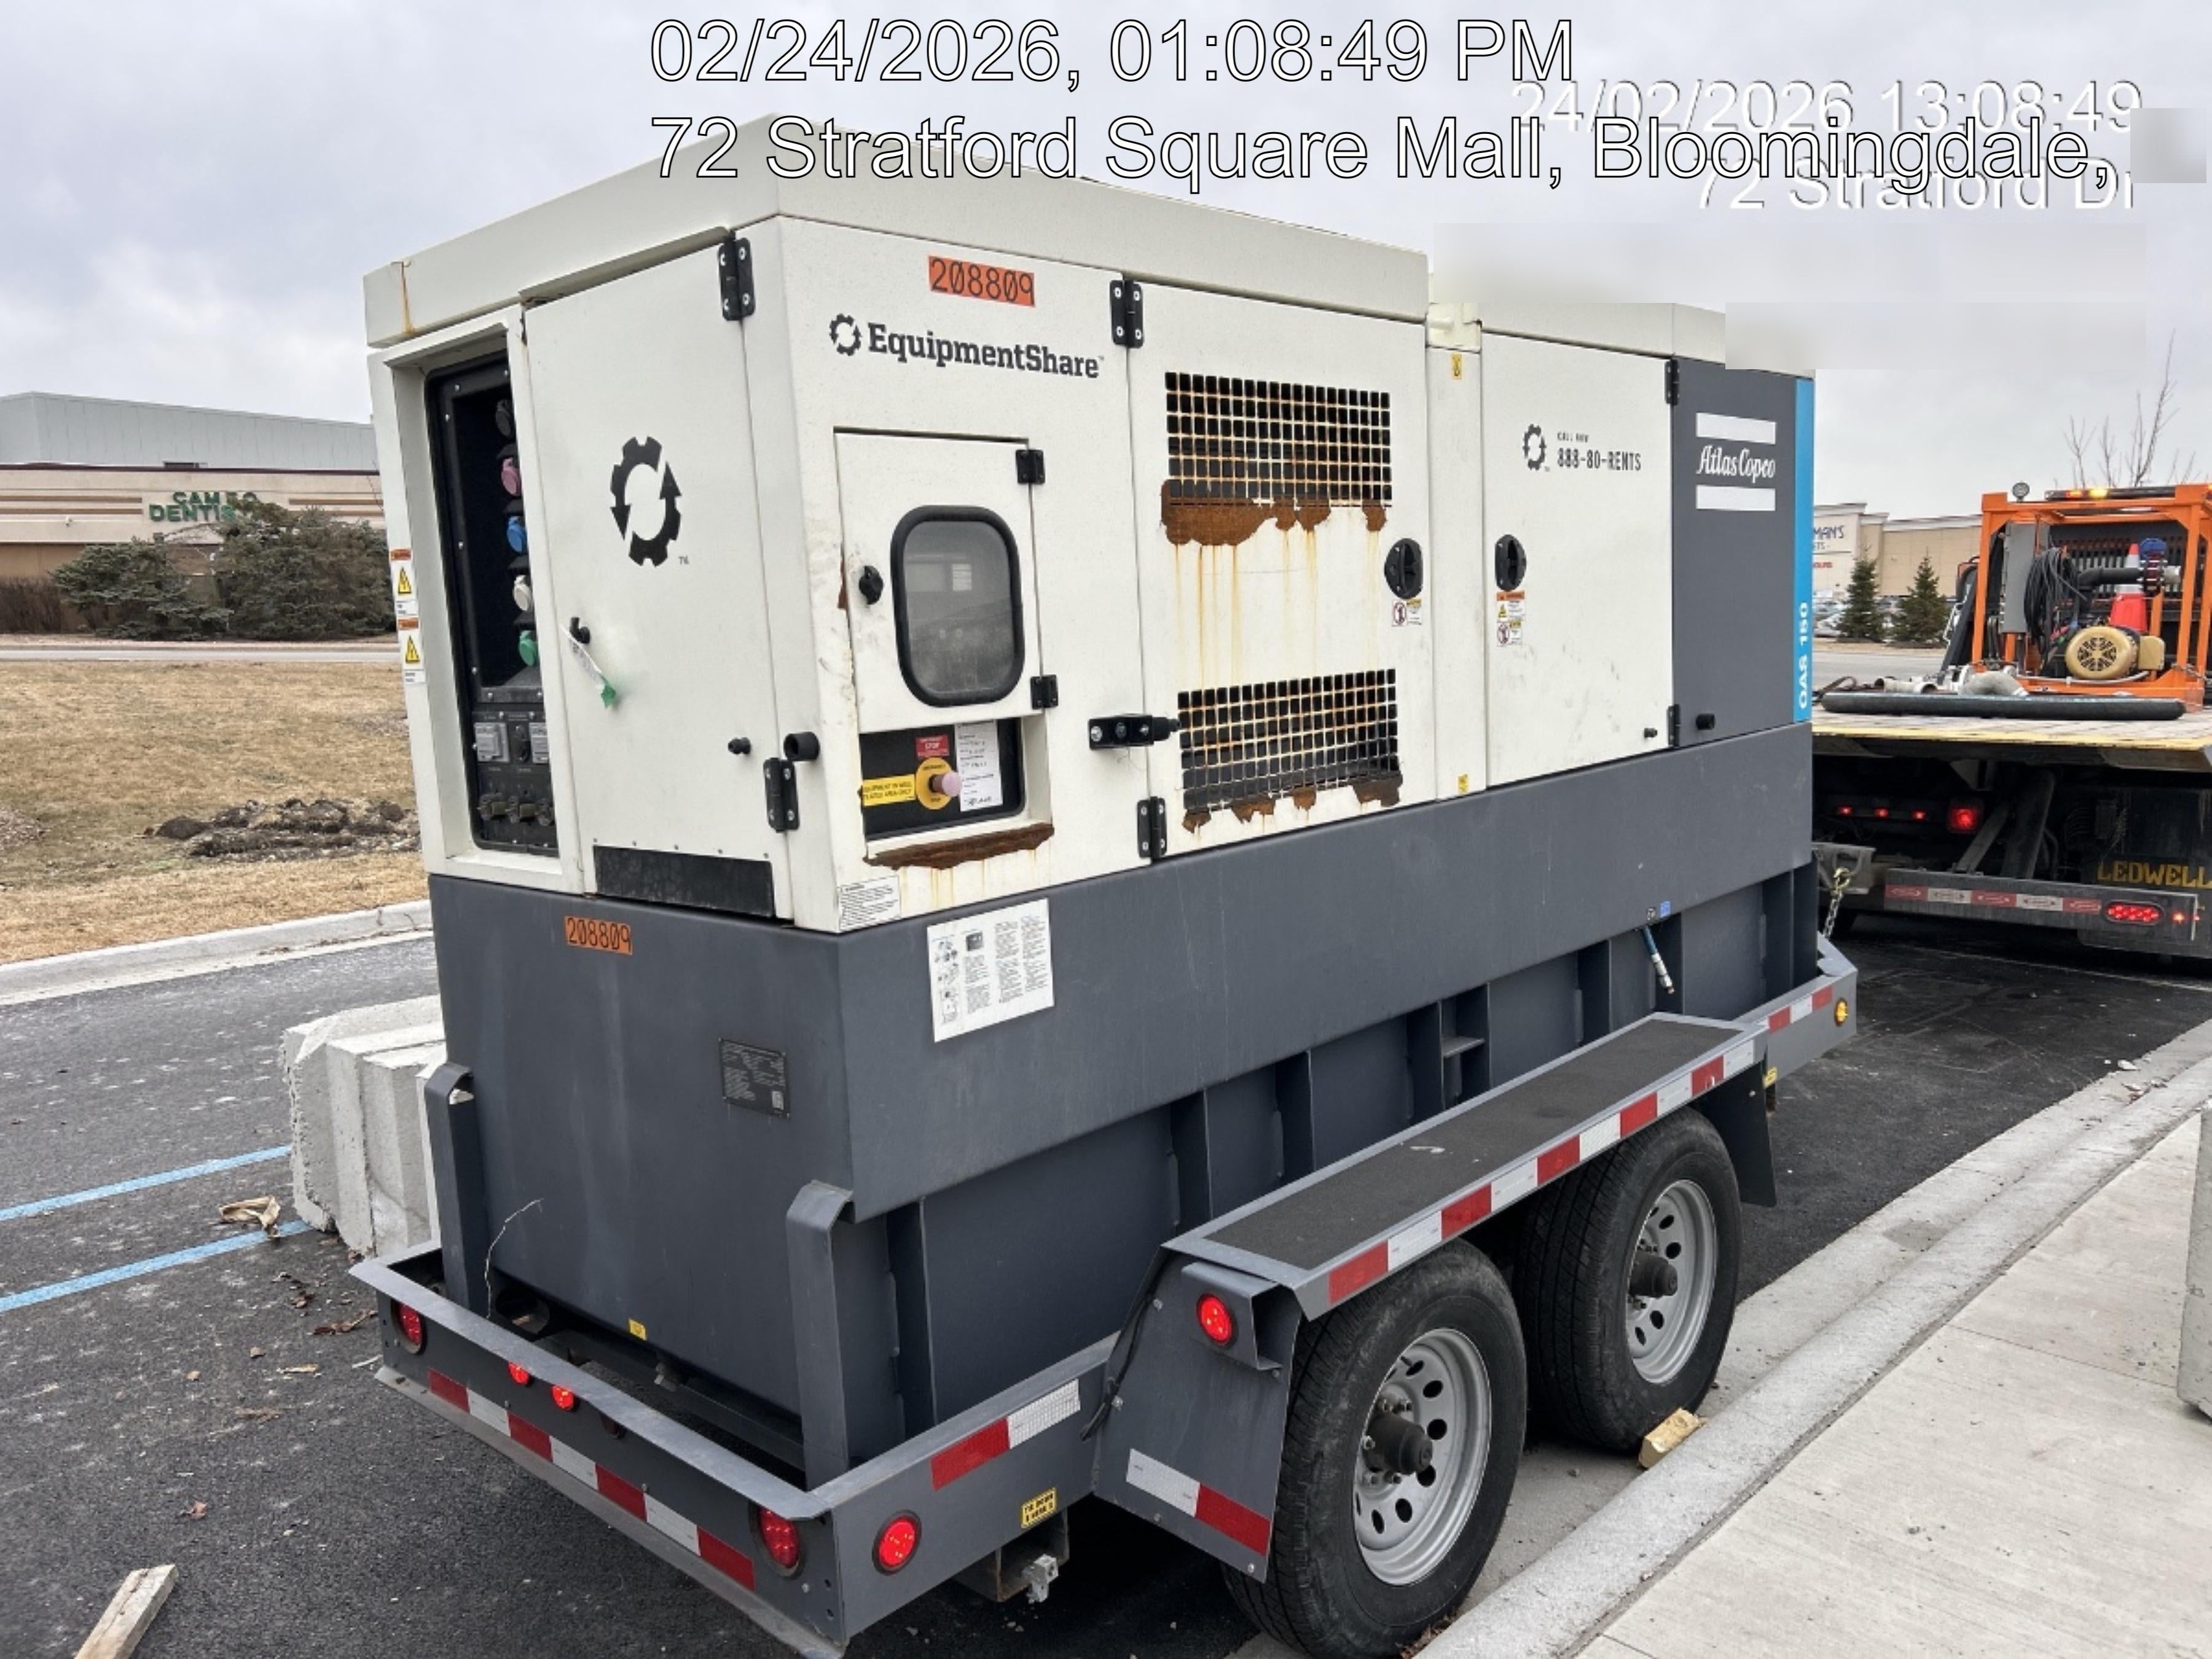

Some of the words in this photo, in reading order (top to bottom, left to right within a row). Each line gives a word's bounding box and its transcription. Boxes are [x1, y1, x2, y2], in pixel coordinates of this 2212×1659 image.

[931, 256, 1035, 307] 208809
[867, 321, 1100, 378] EquipmentShare
[1557, 447, 1642, 471] 888-80-RENTS
[1696, 444, 1738, 477] Atlas
[1738, 447, 1775, 484] Copco
[1813, 525, 1845, 540] MAN'S
[2096, 860, 2212, 889] LEDWELL
[567, 917, 632, 954] 208809
